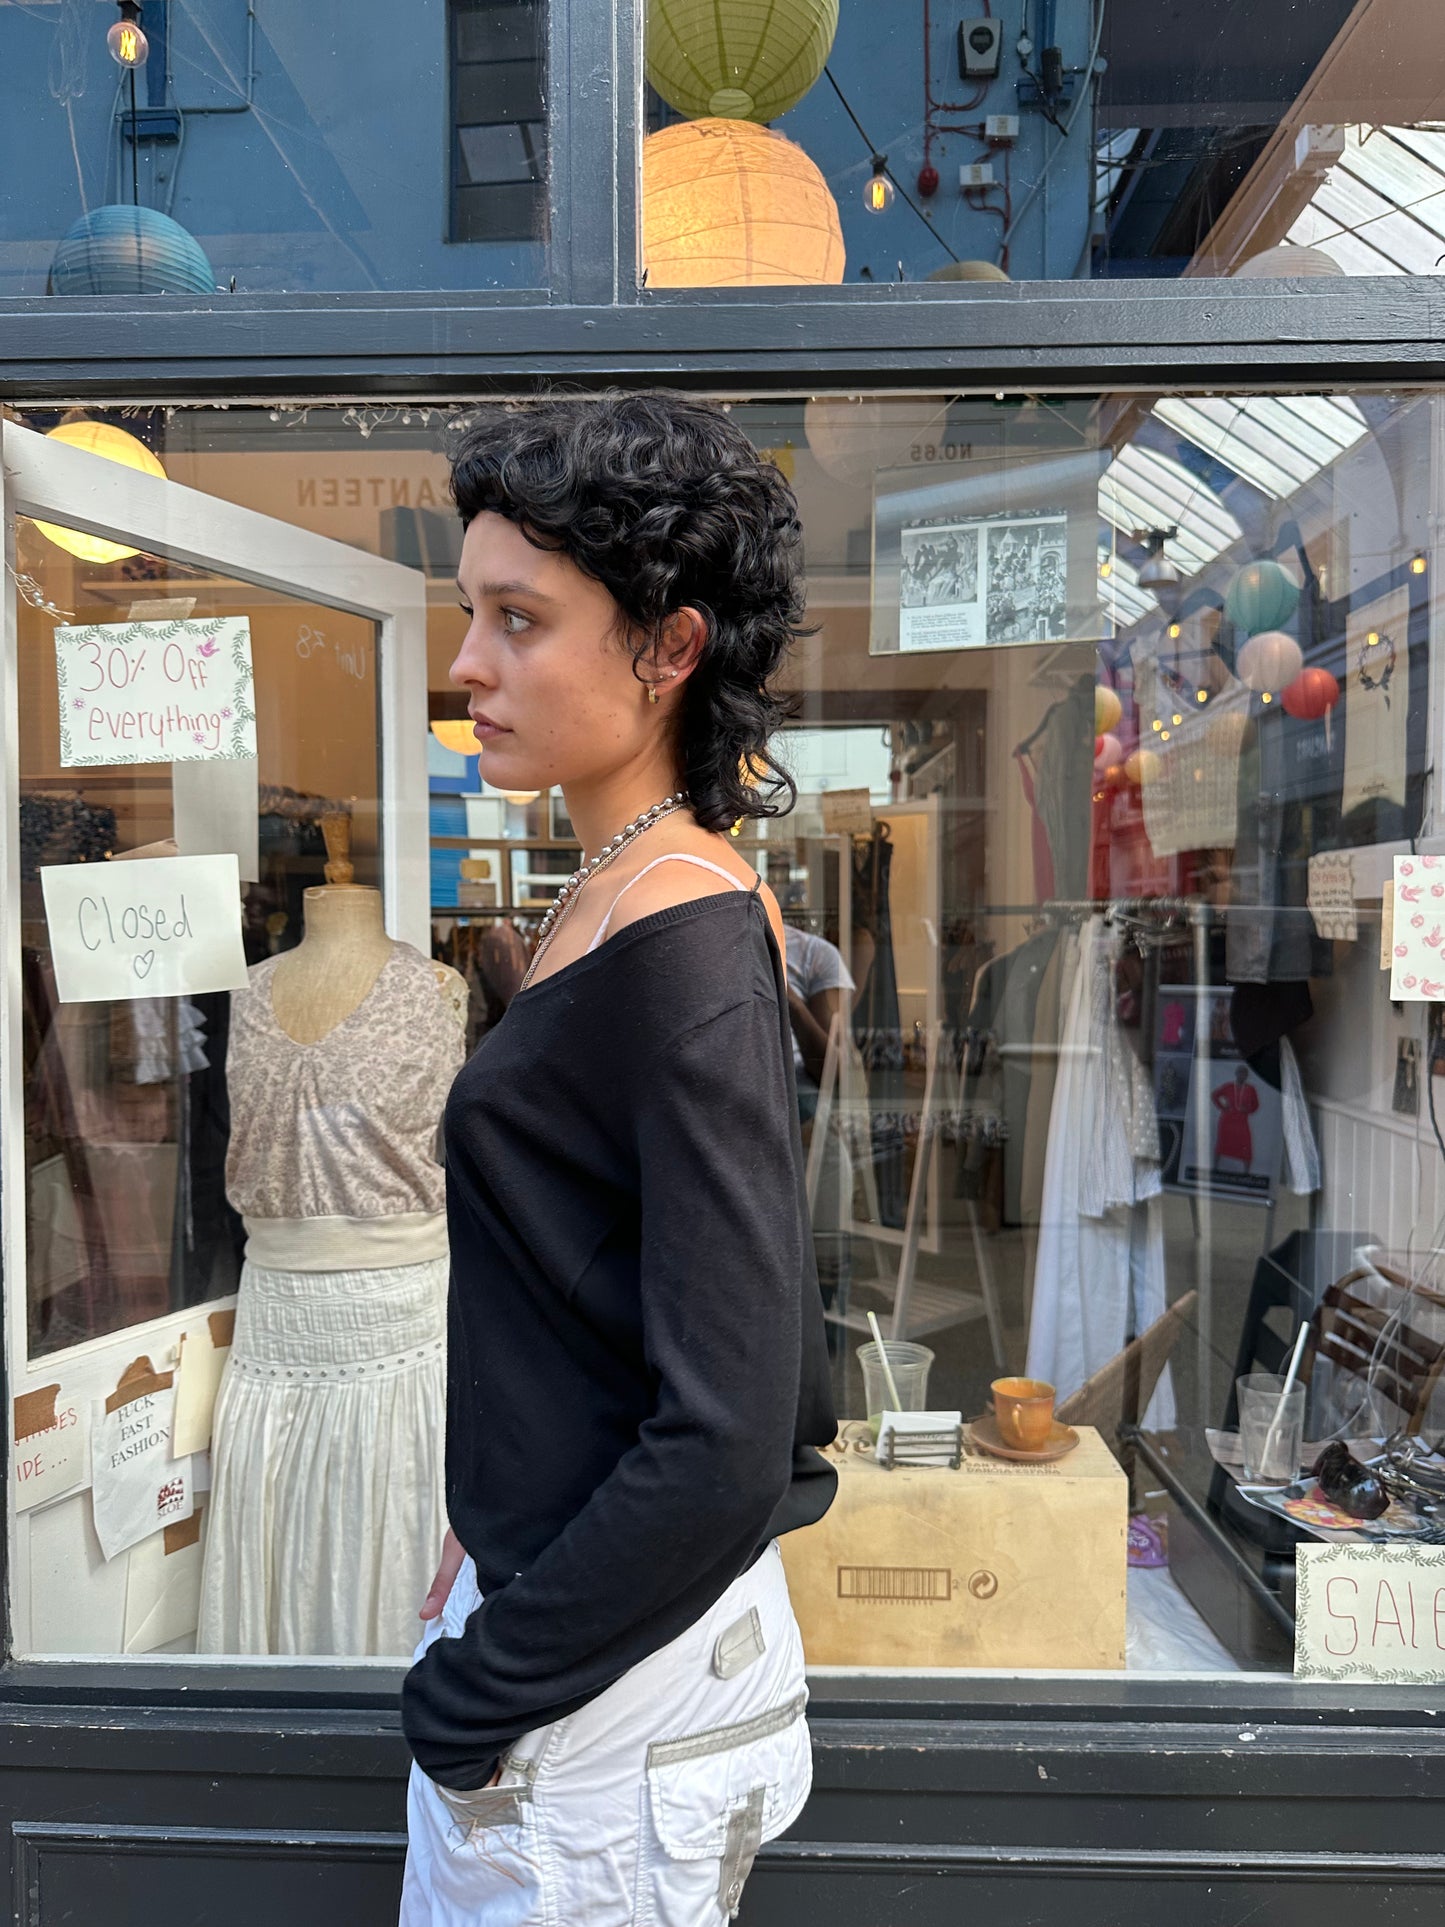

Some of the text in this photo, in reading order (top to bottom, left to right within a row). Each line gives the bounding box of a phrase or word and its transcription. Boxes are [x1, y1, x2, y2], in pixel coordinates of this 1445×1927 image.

[77, 642, 208, 692] 30% Off
[88, 704, 221, 751] everything
[78, 894, 193, 951] Closed
[117, 1394, 155, 1423] FUCK
[120, 1414, 155, 1442] FAST
[110, 1426, 171, 1469] FASHION
